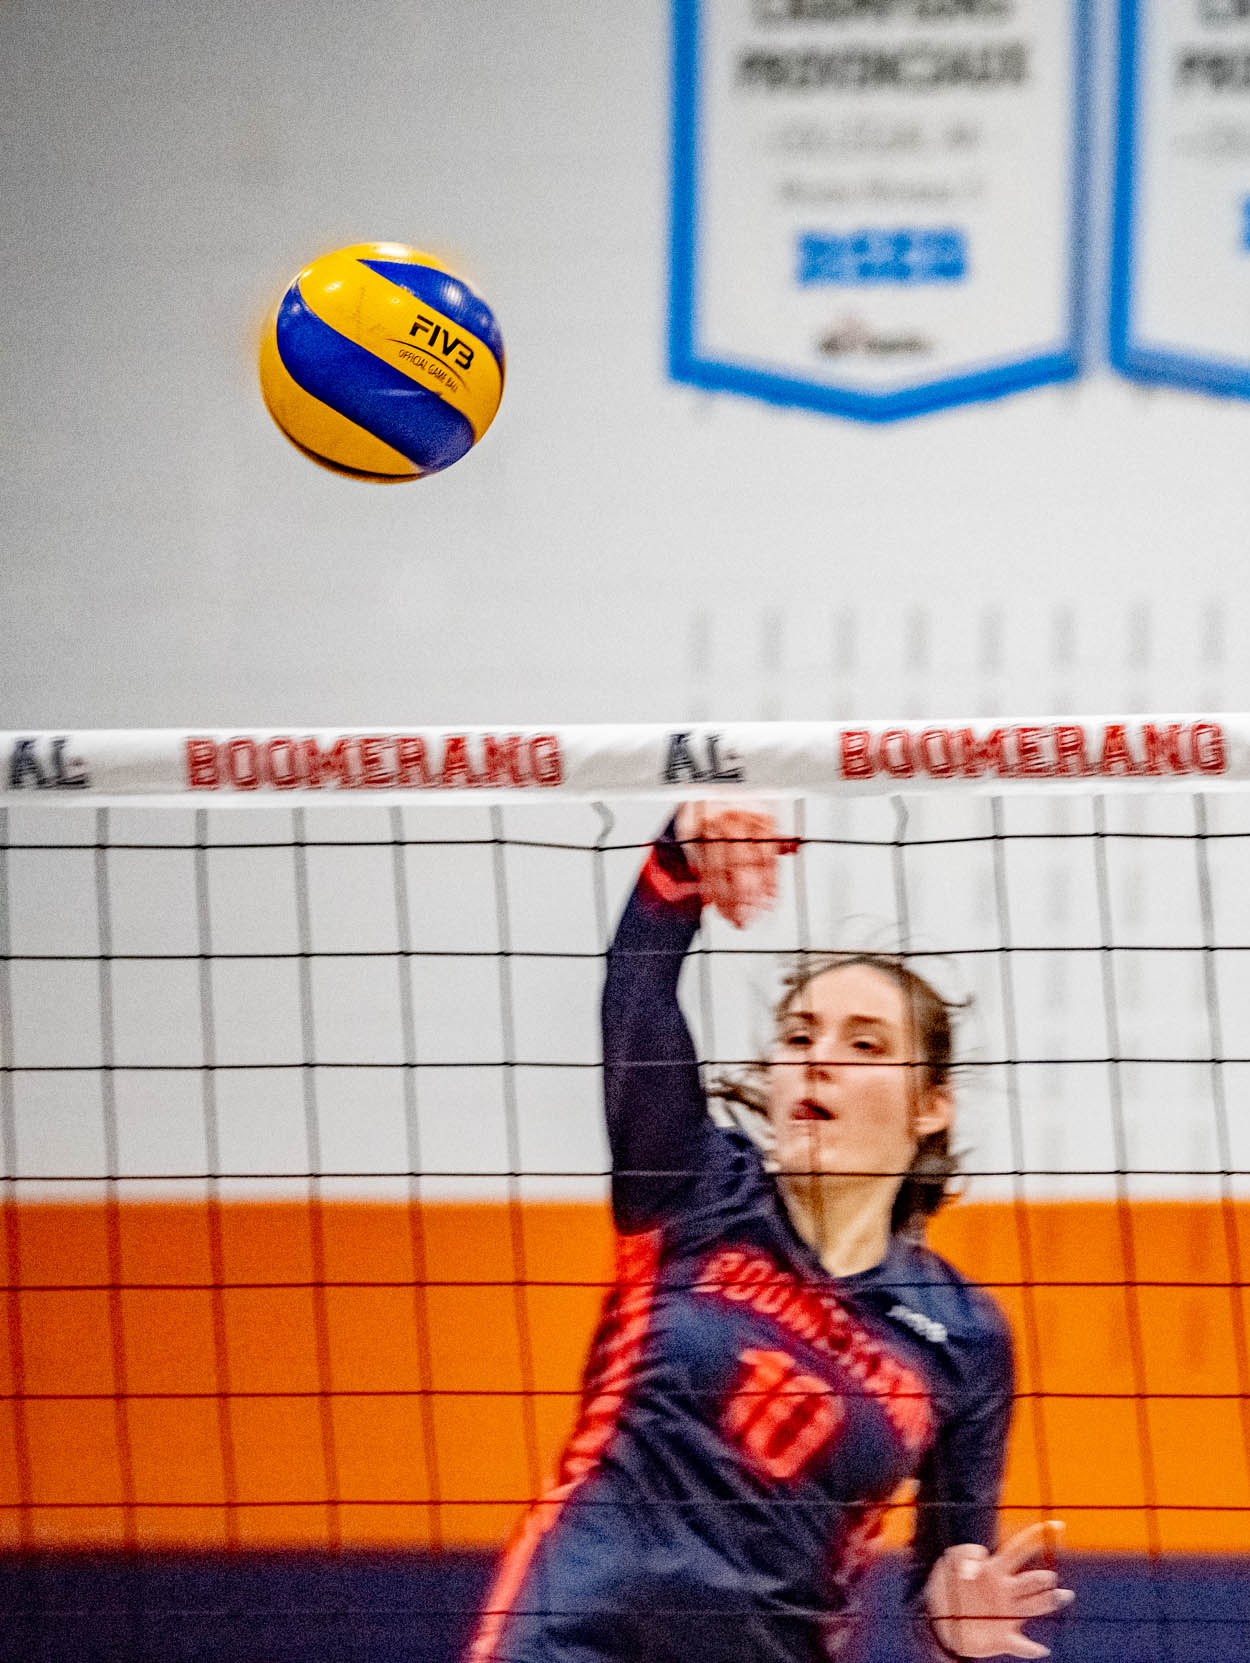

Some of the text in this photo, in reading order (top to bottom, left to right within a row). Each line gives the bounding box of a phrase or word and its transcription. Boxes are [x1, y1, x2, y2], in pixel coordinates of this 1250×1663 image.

[399, 349, 428, 371] OFFICIAL
[428, 363, 447, 383] GAME
[409, 314, 475, 370] FIVB
[184, 732, 563, 791] BOOMERANG
[838, 721, 1228, 780] BOOMERANG
[724, 1348, 844, 1478] 10
